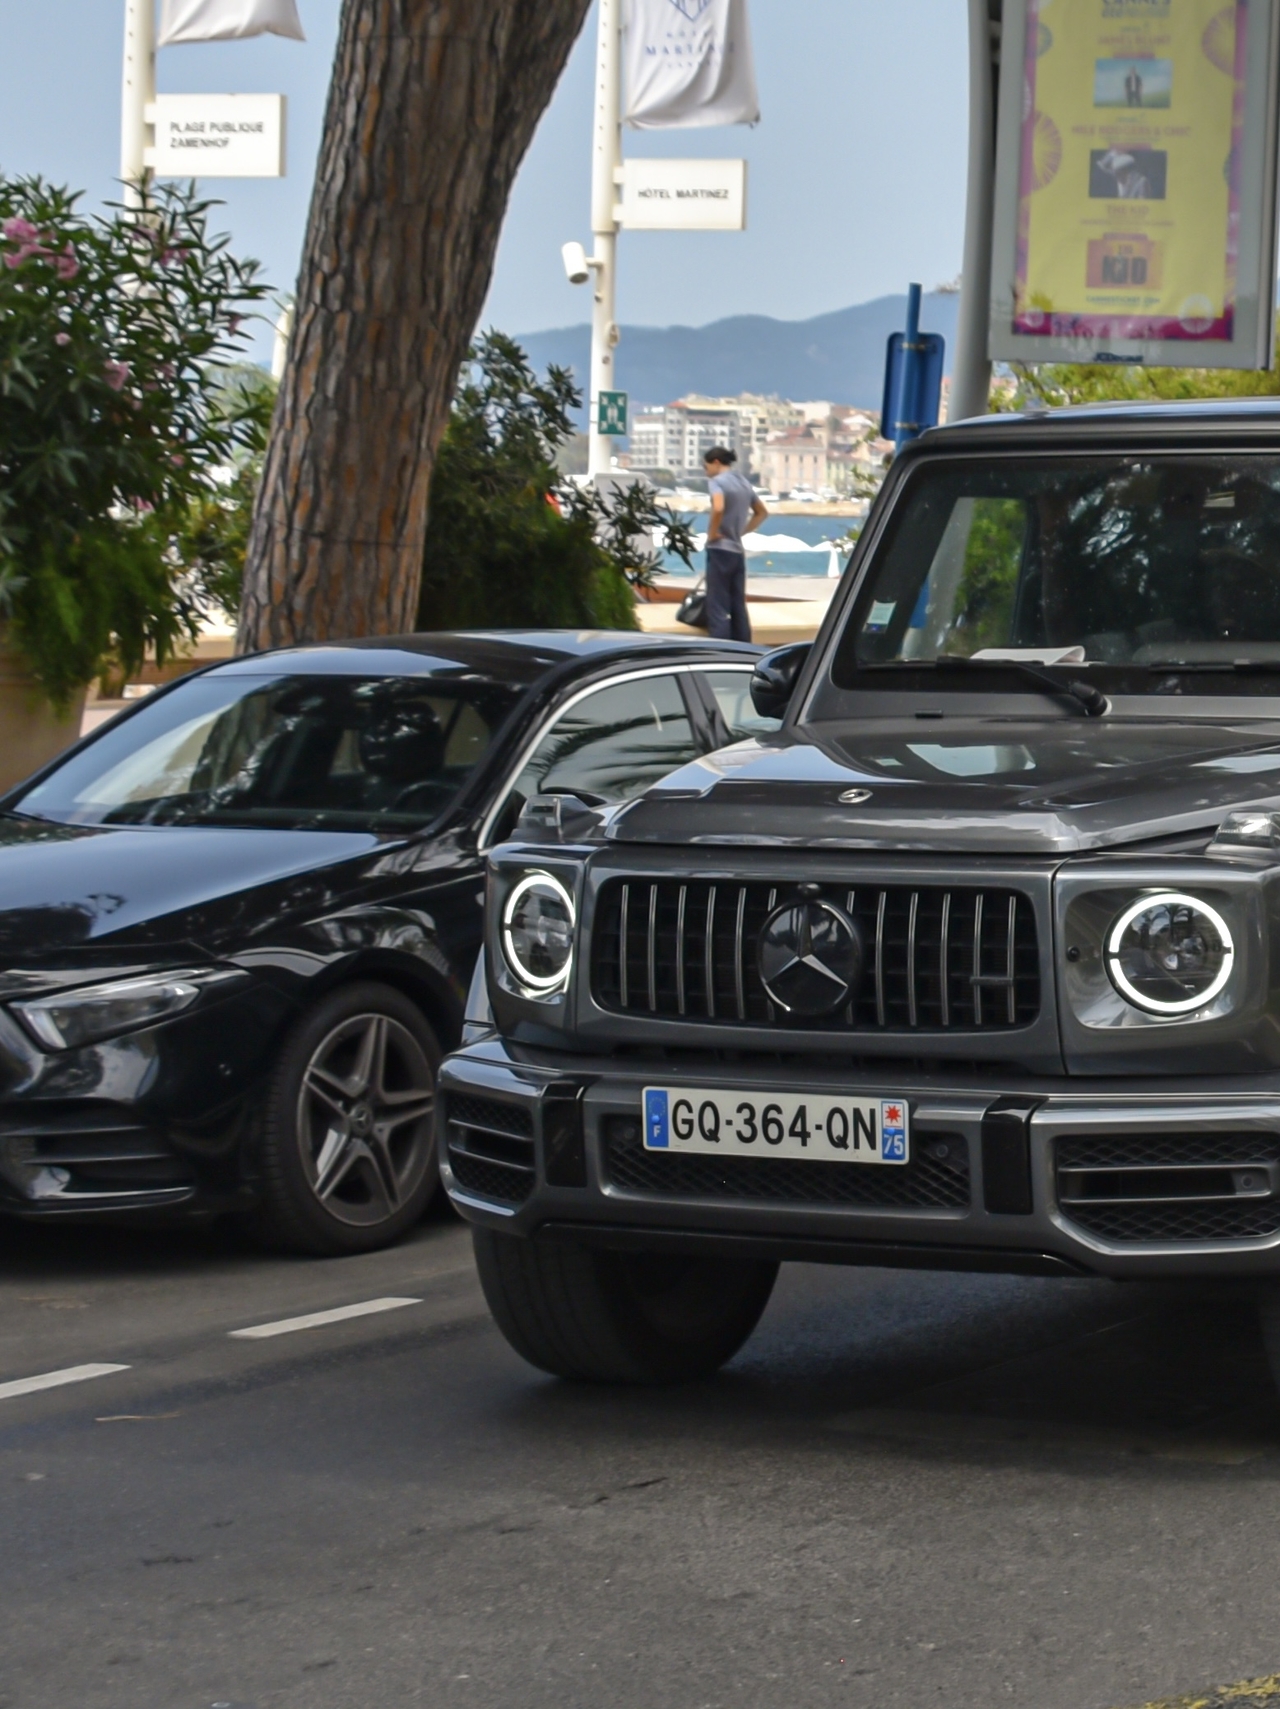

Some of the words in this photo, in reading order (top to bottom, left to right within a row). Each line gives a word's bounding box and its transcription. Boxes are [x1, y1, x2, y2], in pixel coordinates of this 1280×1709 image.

[169, 121, 205, 133] PLAGE
[209, 121, 264, 133] PUBLIQUE
[676, 188, 729, 199] MARTINEZ
[672, 1099, 877, 1150] GQ-364-QN
[653, 1125, 662, 1137] F
[883, 1133, 904, 1155] 75
